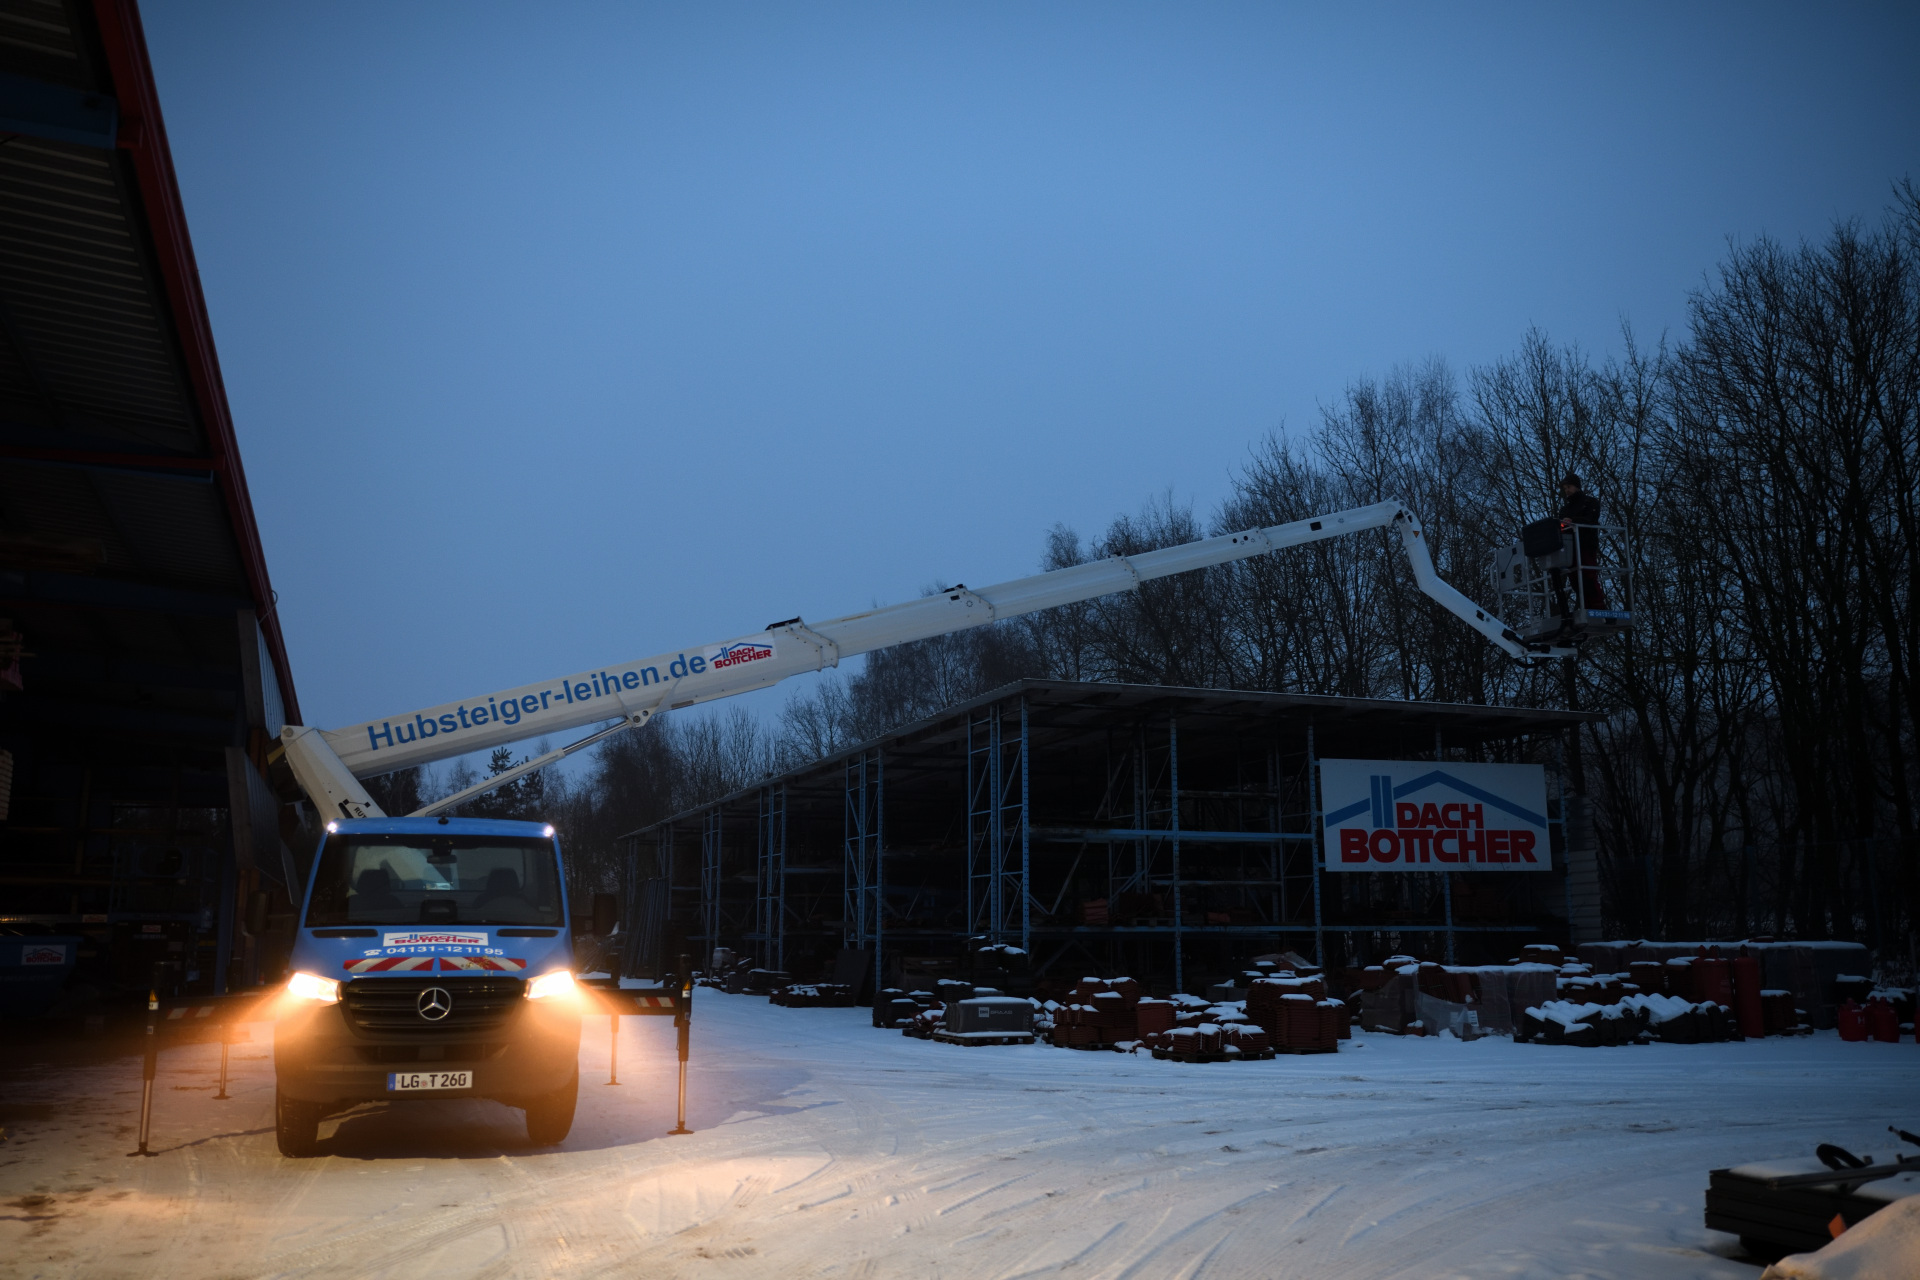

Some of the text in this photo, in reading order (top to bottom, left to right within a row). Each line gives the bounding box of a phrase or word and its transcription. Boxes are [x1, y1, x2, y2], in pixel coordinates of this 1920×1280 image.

[729, 646, 755, 658] DACH
[367, 653, 707, 751] Hubsteiger-leihen.de
[1396, 802, 1484, 829] DACH
[401, 1073, 467, 1088] LG T 260
